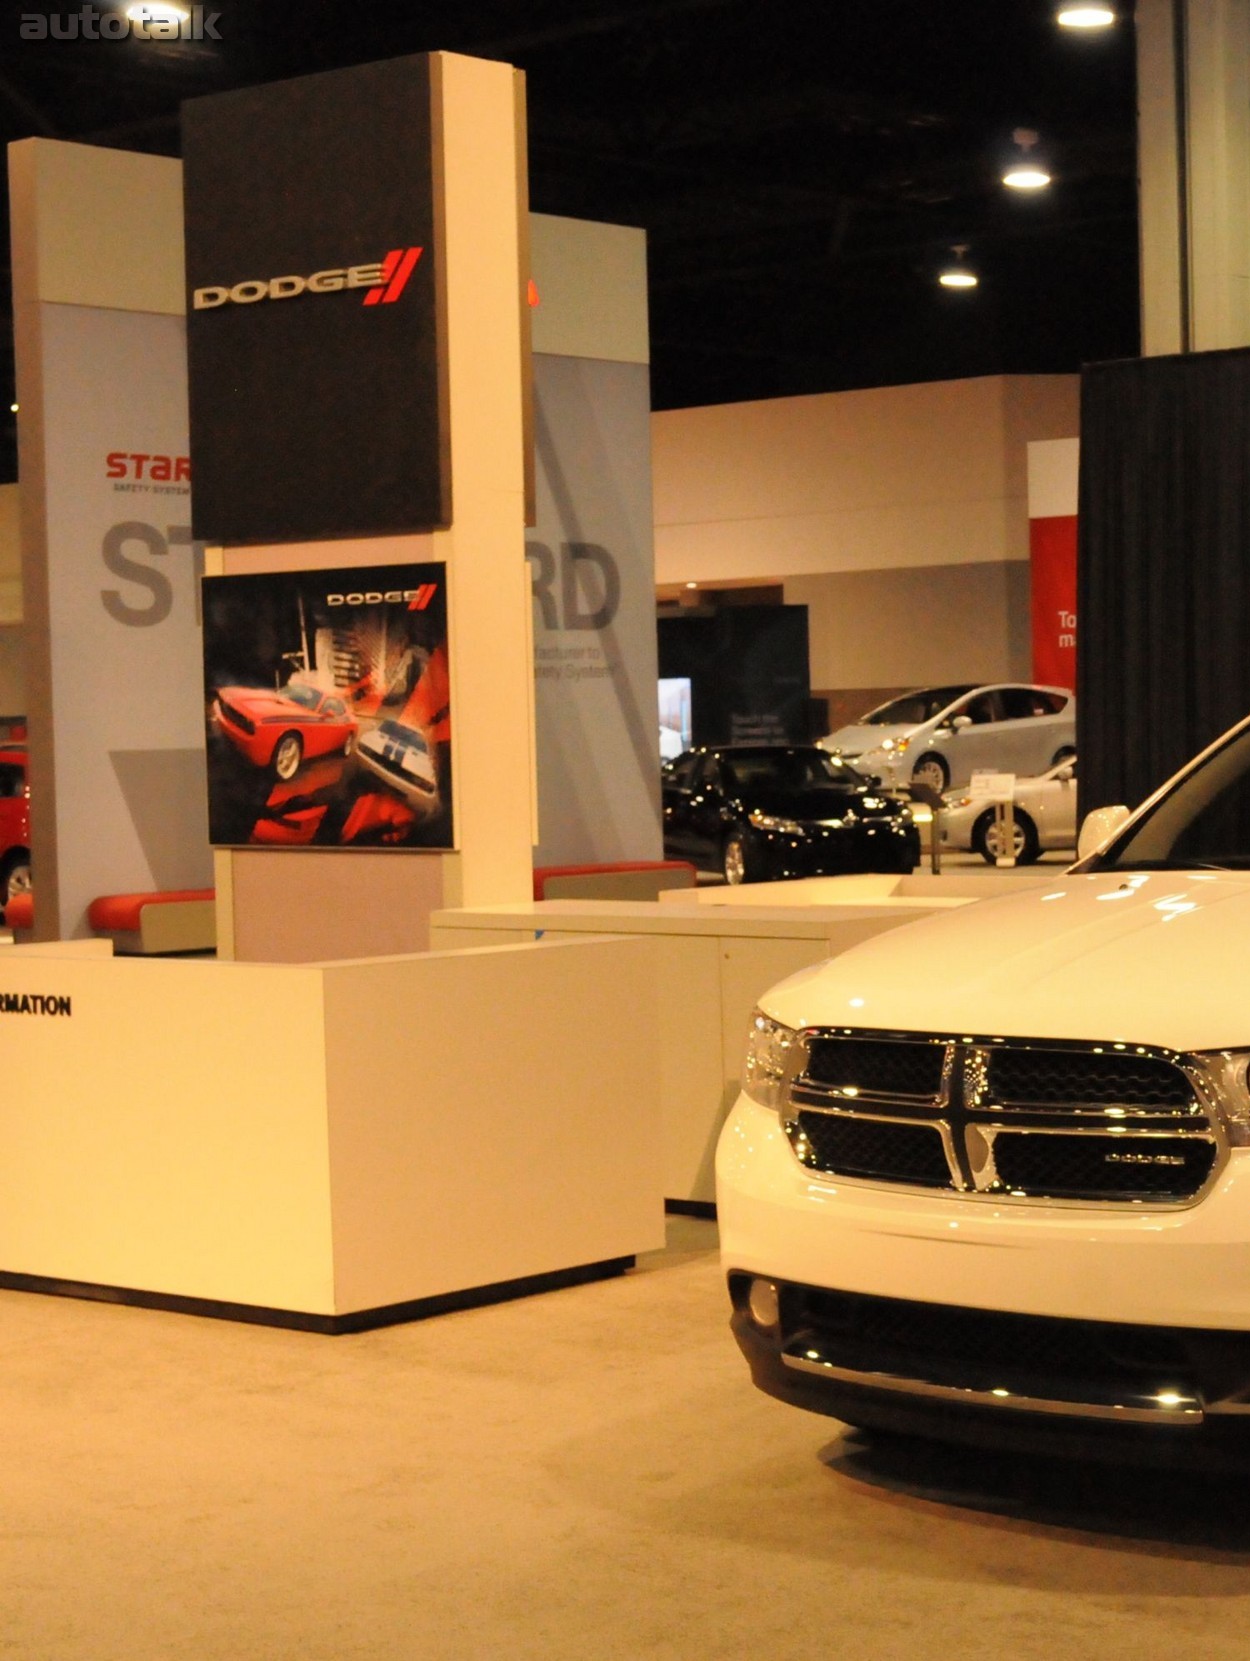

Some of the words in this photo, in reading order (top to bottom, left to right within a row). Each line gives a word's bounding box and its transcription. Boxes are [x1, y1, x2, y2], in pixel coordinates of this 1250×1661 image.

[193, 263, 389, 310] DODGE
[326, 590, 420, 606] DODGE
[1104, 1153, 1185, 1166] DODGE
